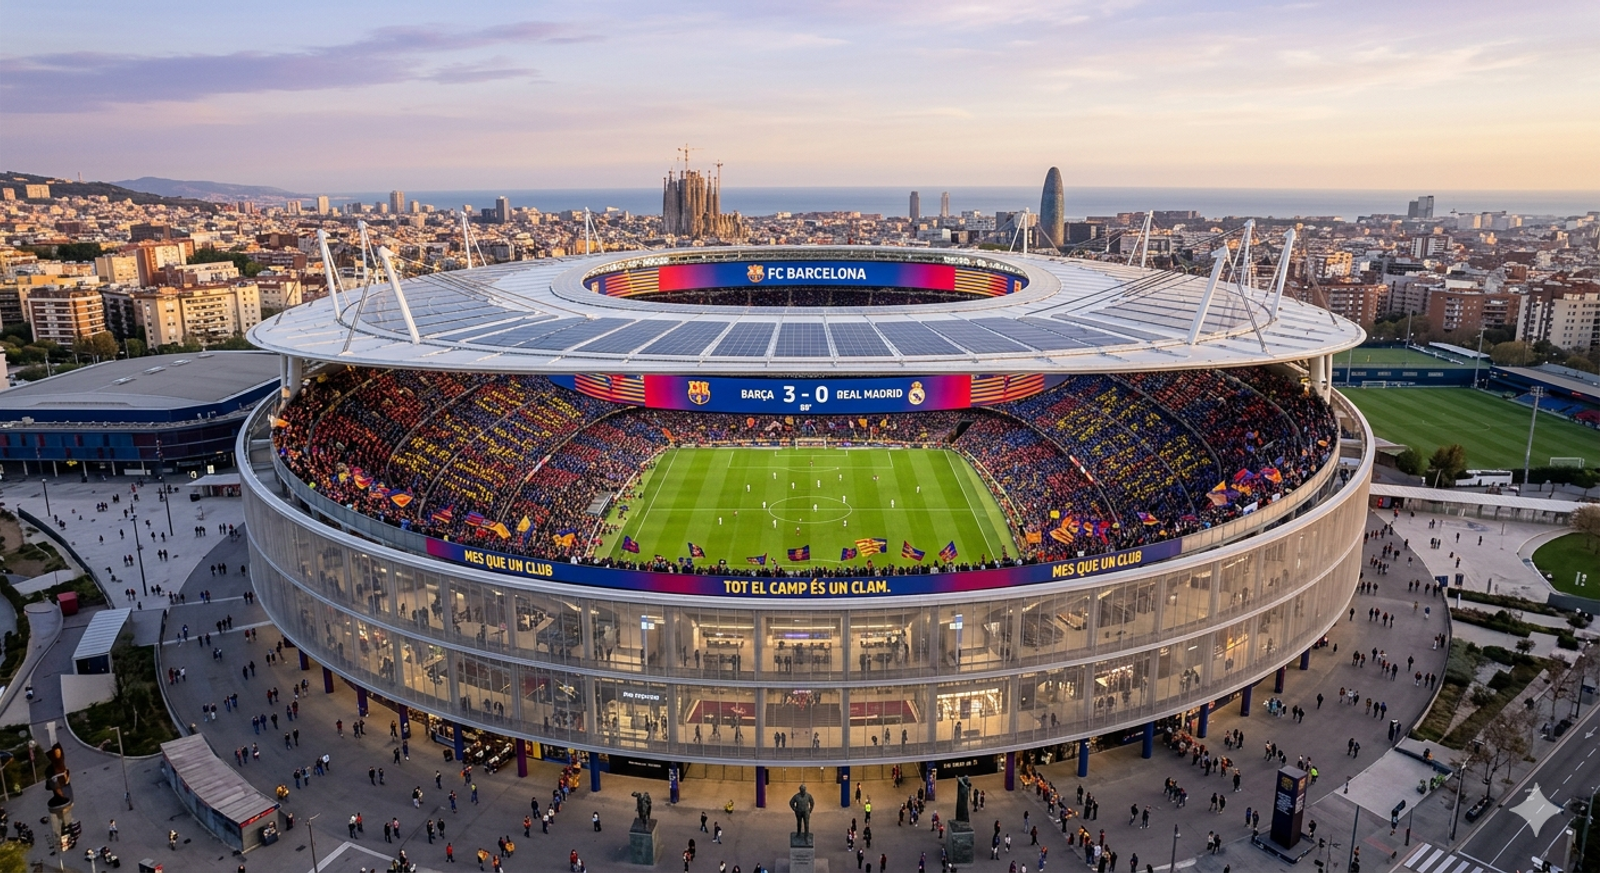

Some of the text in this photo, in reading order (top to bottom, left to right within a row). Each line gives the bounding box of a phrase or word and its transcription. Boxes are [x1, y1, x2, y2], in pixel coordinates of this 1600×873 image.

[768, 267, 867, 280] FC BARCELONA
[741, 389, 775, 402] BARÇA
[783, 385, 796, 403] 3
[815, 385, 829, 403] 0
[836, 389, 863, 400] REAL
[864, 388, 903, 399] MADRID
[464, 549, 553, 577] MES QUE UN CLUB
[1052, 550, 1142, 578] MES QUE UN CLUB
[723, 578, 892, 595] TOT EL CAMP ÉS UN CLAM.
